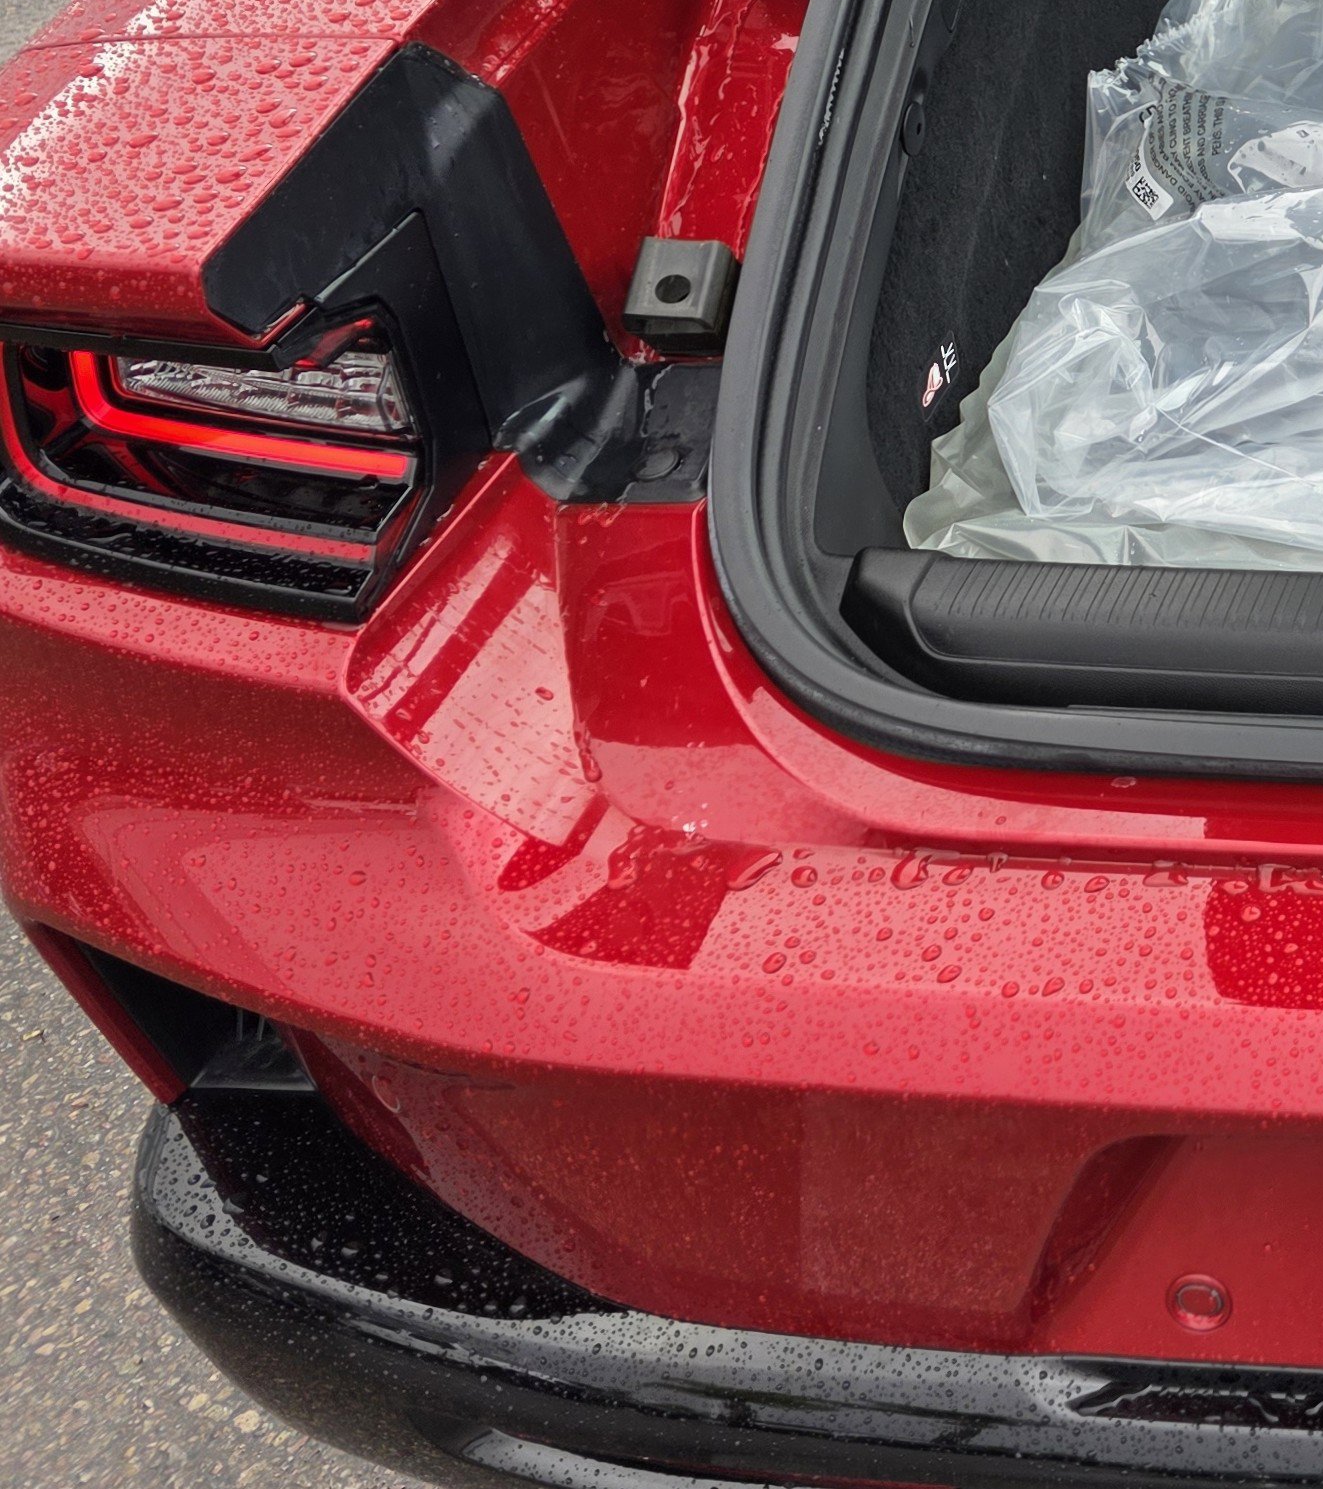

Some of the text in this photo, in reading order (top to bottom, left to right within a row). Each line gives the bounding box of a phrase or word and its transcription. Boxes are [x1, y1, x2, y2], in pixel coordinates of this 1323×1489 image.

[1167, 103, 1177, 119] TO
[1212, 107, 1223, 128] THIS
[1168, 118, 1178, 149] CLING
[1196, 137, 1207, 157] AND
[1149, 144, 1178, 186] DANGER
